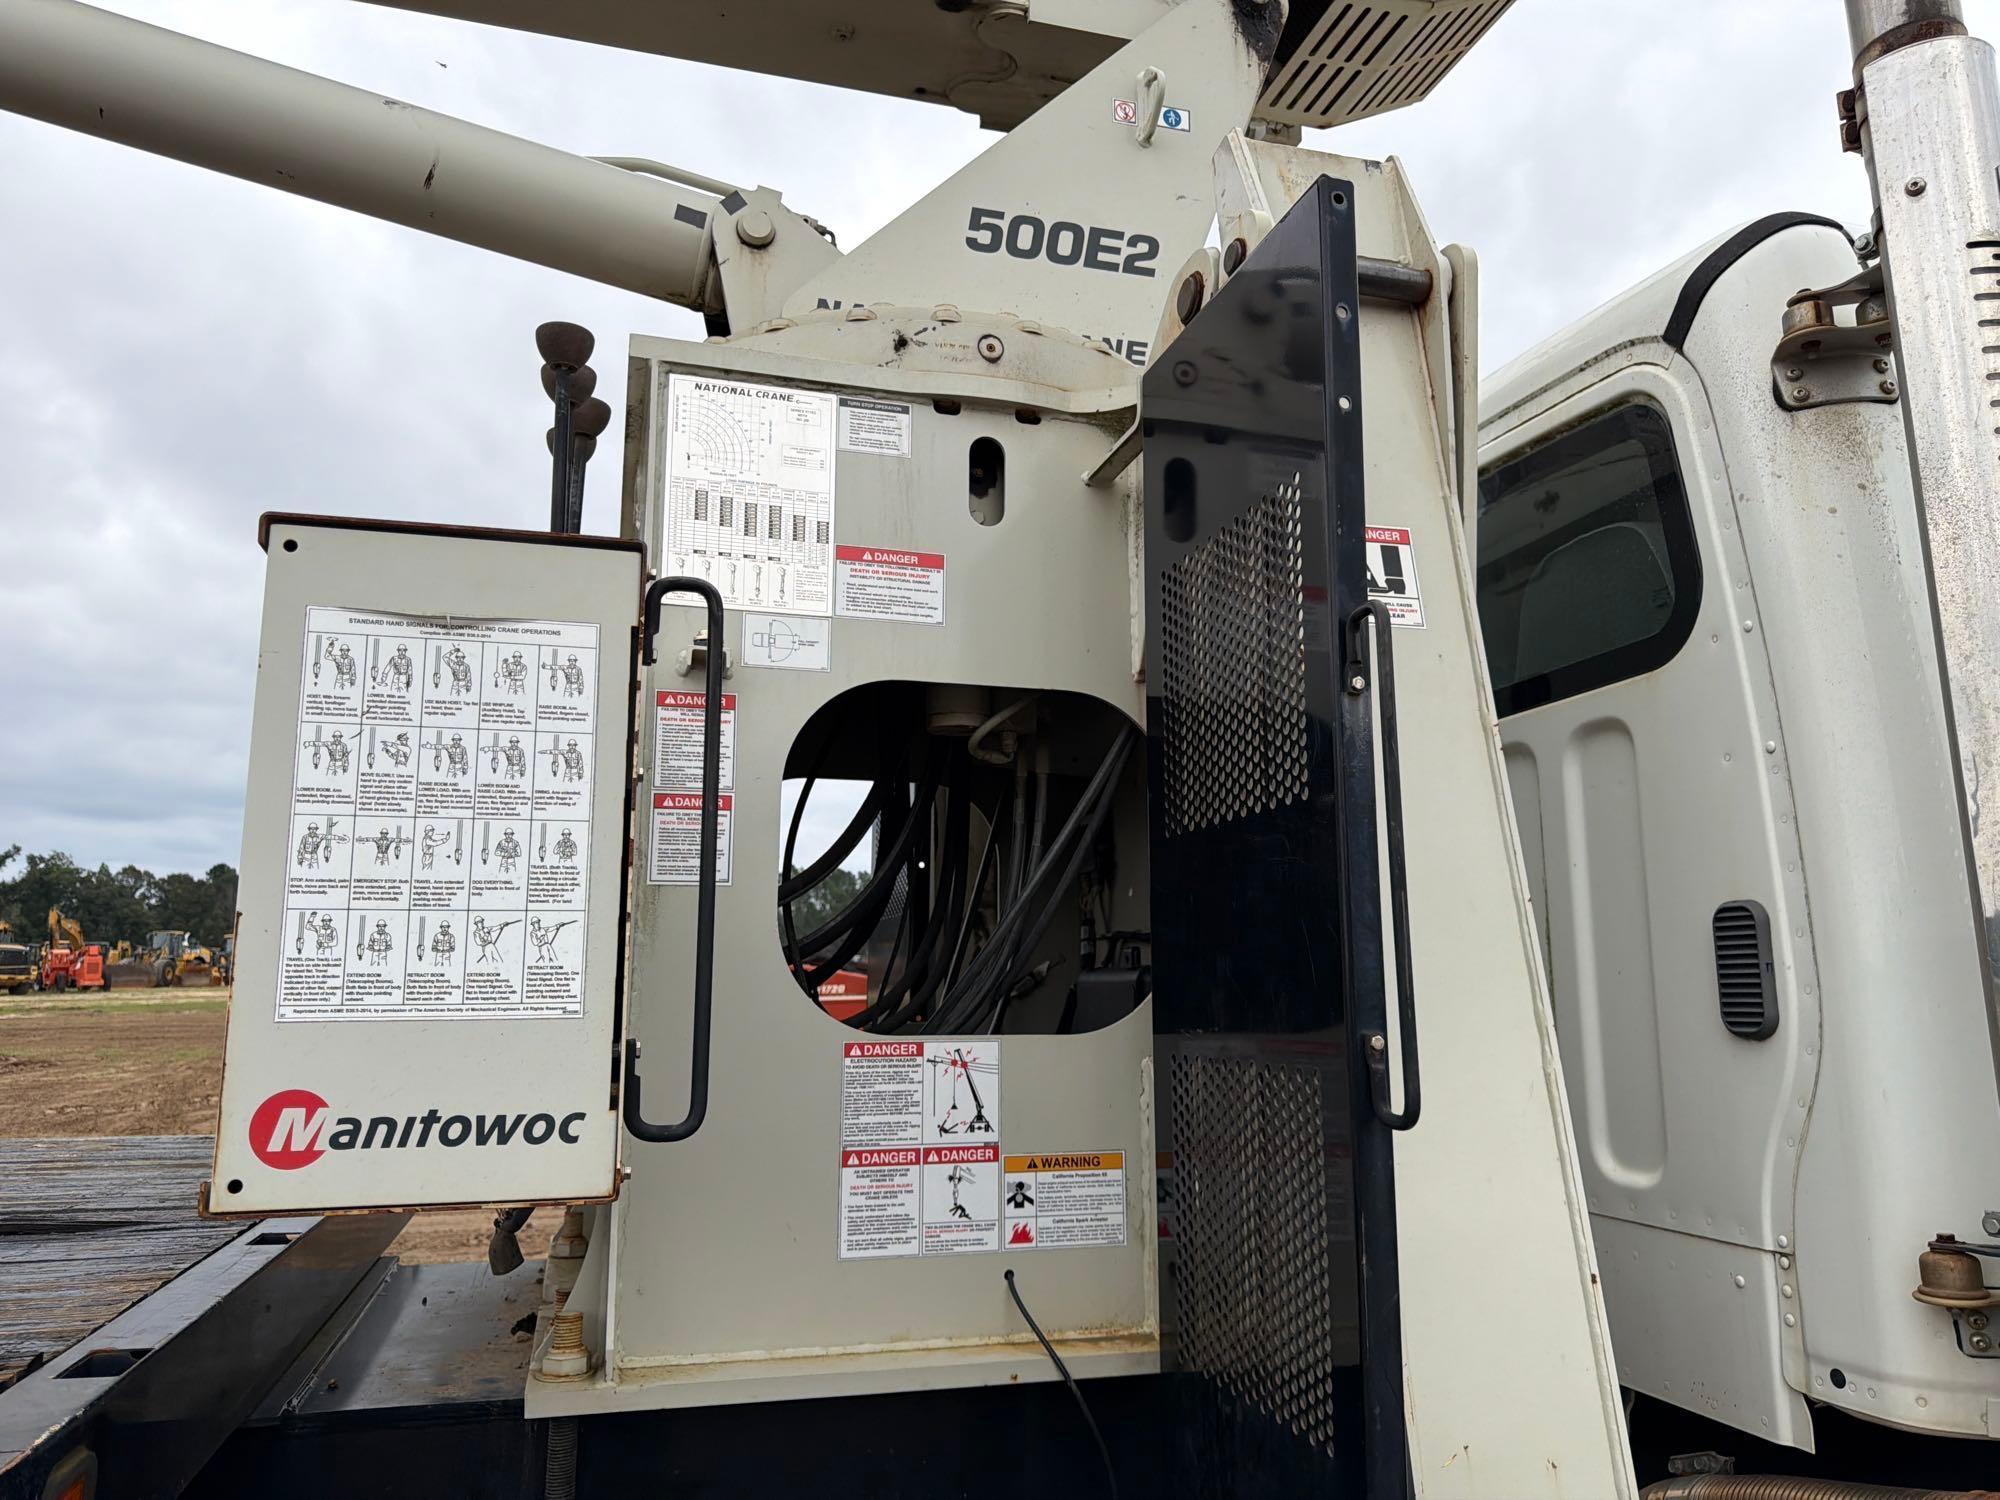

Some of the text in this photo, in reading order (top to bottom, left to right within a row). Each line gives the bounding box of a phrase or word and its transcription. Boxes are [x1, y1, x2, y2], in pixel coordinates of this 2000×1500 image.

[965, 206, 1161, 278] 500E2
[694, 382, 794, 403] NATIONAL CRANE
[874, 403, 902, 412] OPERATION
[874, 552, 919, 565] DANGER
[880, 570, 907, 578] SERIOUS
[349, 618, 384, 626] STANDARD
[450, 624, 496, 632] CONTROLLING
[520, 628, 561, 636] OPERATIONS
[677, 695, 726, 707] DANR
[675, 797, 723, 808] DANR
[864, 1044, 917, 1056] DANGER
[266, 1107, 586, 1152] Manitowoc
[861, 1152, 916, 1164] DANGER
[941, 1149, 994, 1161] DANGER
[1041, 1156, 1101, 1168] WARNING
